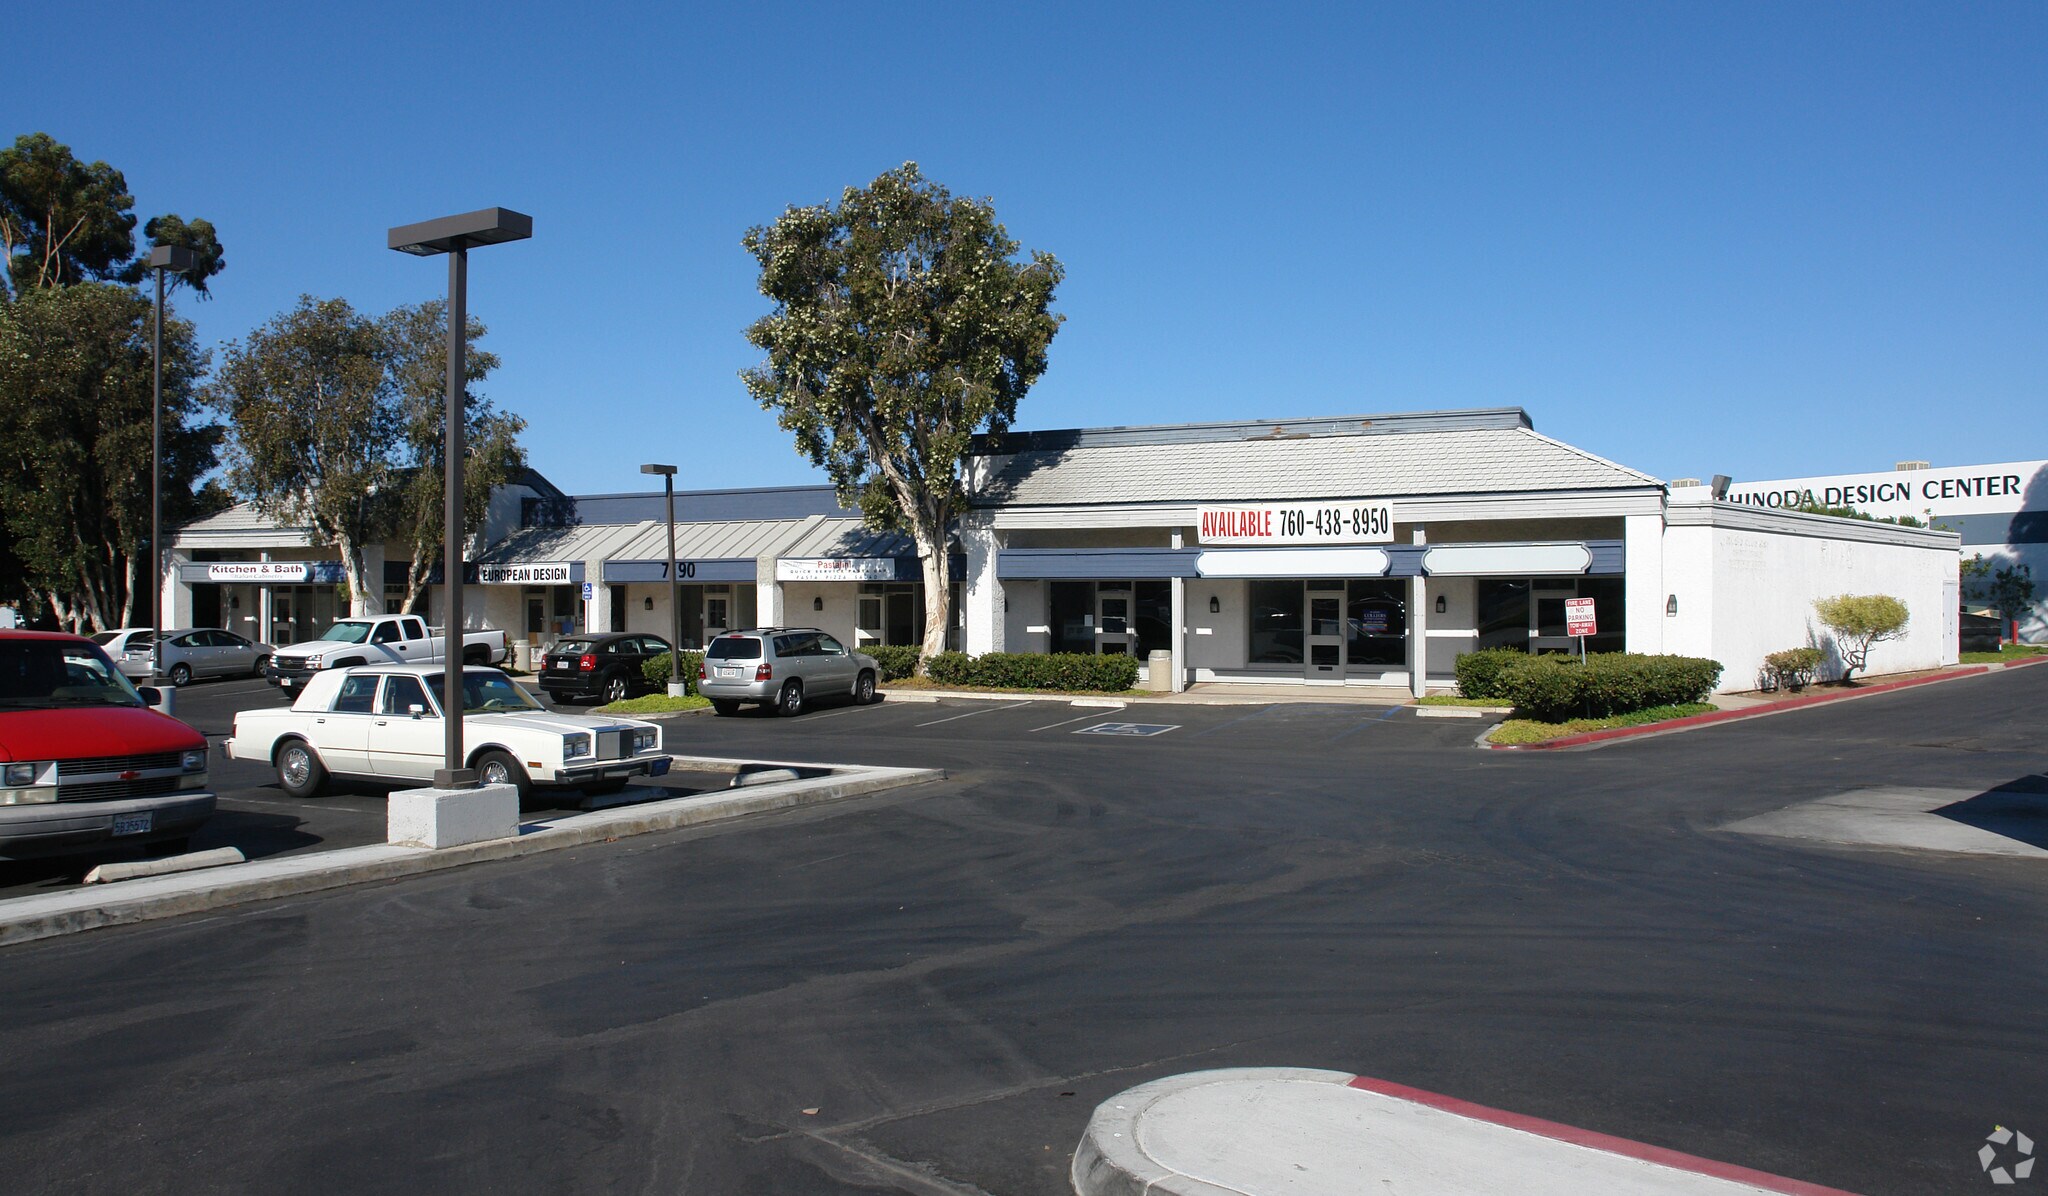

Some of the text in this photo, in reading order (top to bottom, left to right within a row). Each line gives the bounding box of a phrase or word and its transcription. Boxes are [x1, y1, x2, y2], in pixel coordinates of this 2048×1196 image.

[1729, 475, 2021, 510] HINODA DESIGN CENTER
[1202, 507, 1389, 537] AVAILABLE 760-438-8950
[211, 565, 303, 573] Kitchen & Bath
[482, 567, 567, 581] EUROPEAN DESIGN
[661, 562, 696, 578] 790
[1567, 613, 1594, 621] PARKING
